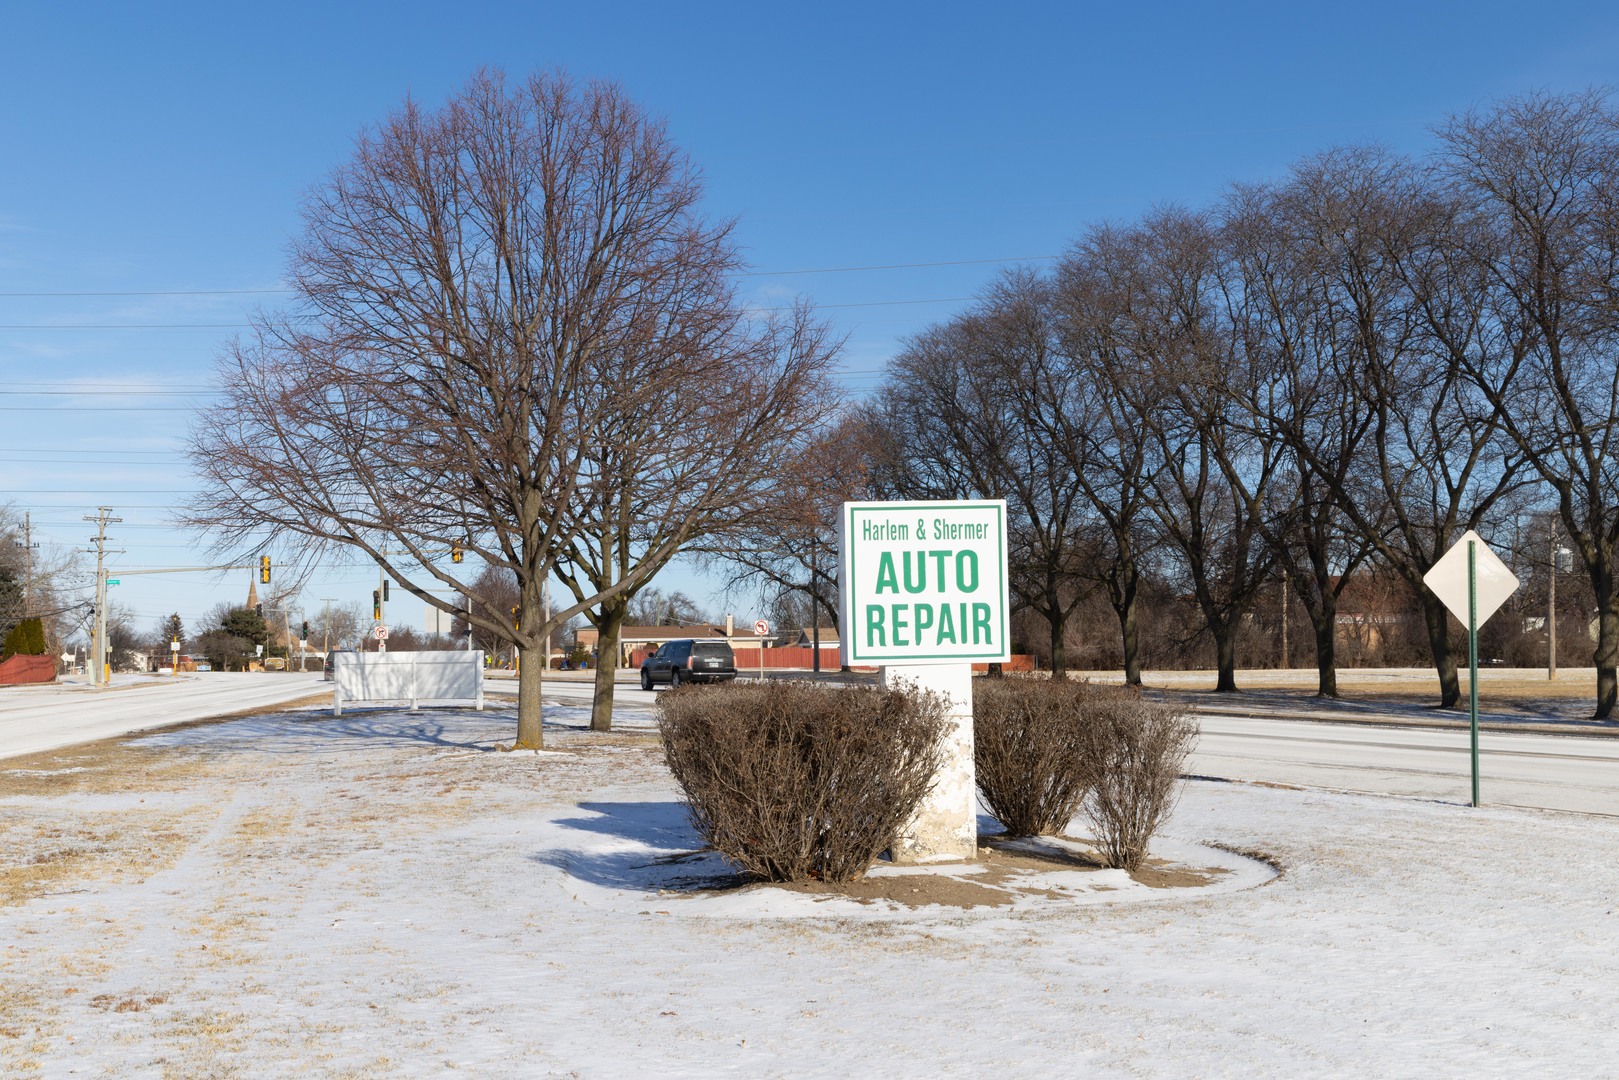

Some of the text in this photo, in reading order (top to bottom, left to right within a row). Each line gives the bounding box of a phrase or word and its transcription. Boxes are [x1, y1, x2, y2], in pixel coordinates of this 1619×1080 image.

[863, 518, 989, 541] Harlem & Shermer
[875, 549, 979, 594] AUTO
[866, 602, 993, 647] REPAIR
